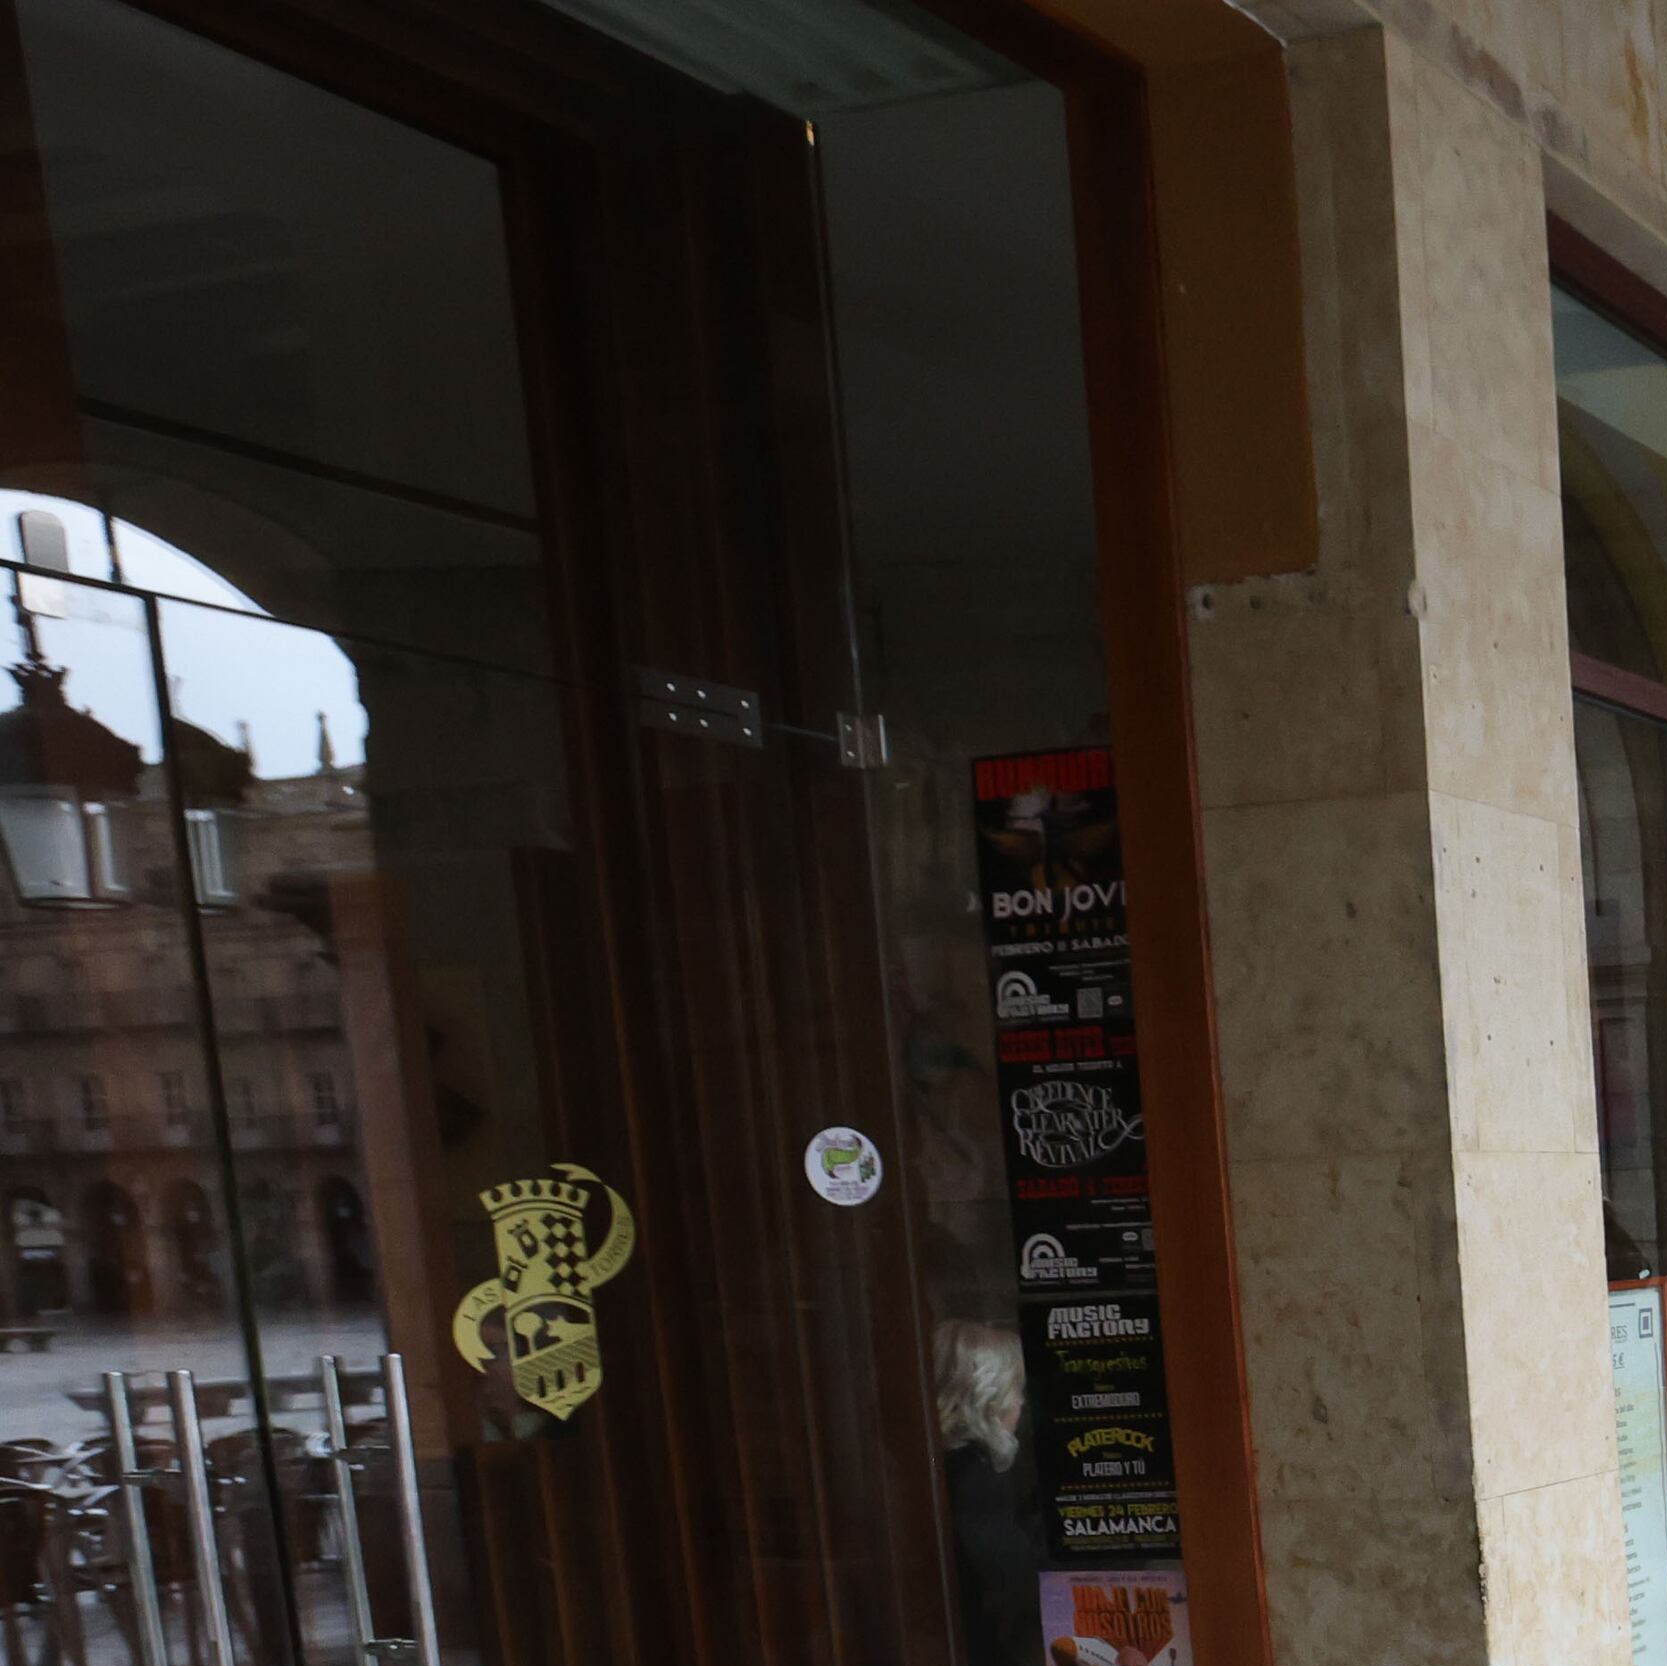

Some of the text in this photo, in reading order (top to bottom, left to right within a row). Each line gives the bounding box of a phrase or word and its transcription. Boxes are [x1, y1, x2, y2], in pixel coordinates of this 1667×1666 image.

[992, 880, 1127, 921] BON JOVI
[1011, 1081, 1112, 1113] CREEDENCE
[1013, 1107, 1124, 1134] CLEARWATER
[1018, 1128, 1101, 1167] REVIVAL
[463, 1286, 497, 1322] LAS
[1047, 1304, 1121, 1324] MUSIC
[1048, 1318, 1150, 1340] FACTORY
[1082, 1461, 1122, 1477] PLATERO
[1124, 1461, 1130, 1475] Y
[1057, 1505, 1104, 1518] VIERNES
[1107, 1505, 1124, 1518] 24
[1064, 1516, 1177, 1536] SALAMANCA
[1073, 1611, 1172, 1639] NOSOTROS
